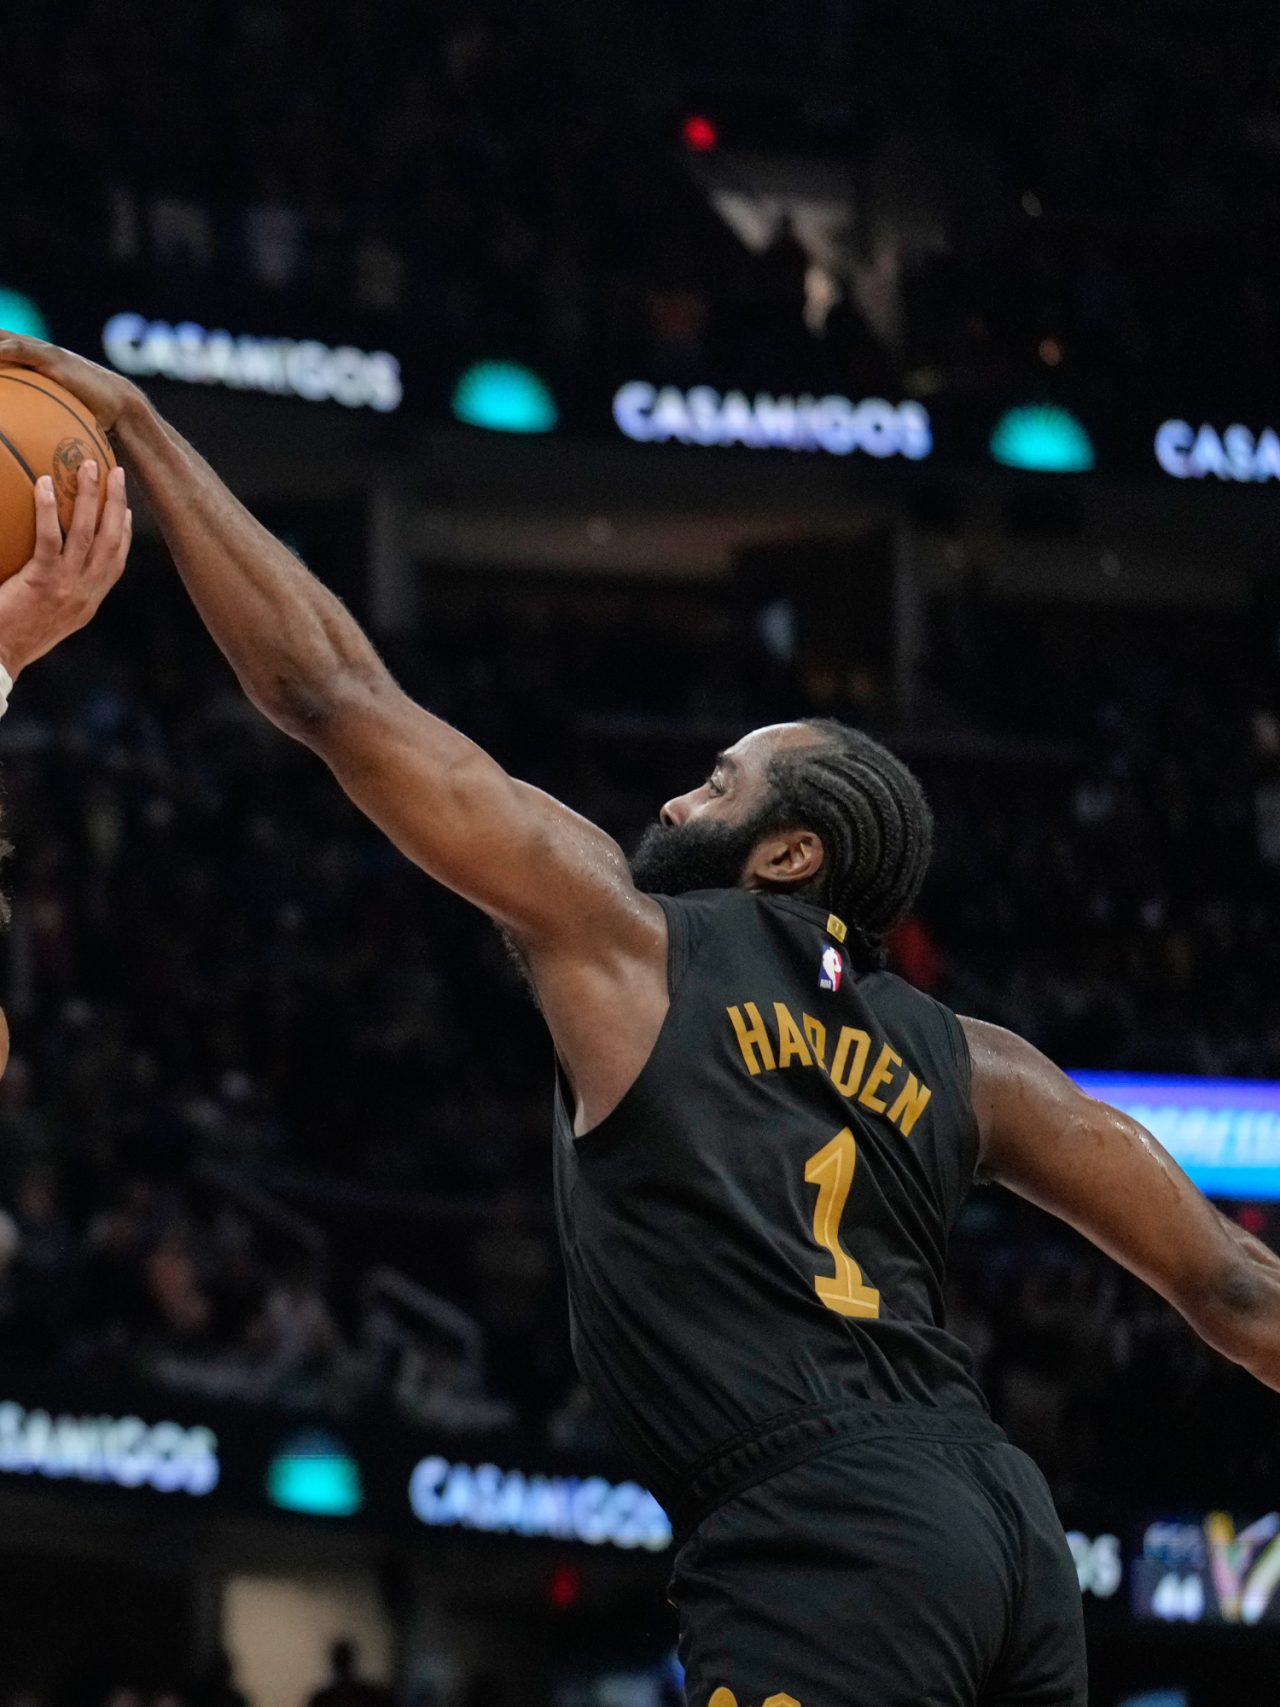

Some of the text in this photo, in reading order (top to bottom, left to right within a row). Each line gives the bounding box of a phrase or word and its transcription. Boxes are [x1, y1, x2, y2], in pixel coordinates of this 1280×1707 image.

[103, 311, 402, 412] CASAMIGOS
[612, 380, 934, 460] CASAMIGOS
[726, 1001, 932, 1137] HARDEN
[804, 1127, 880, 1319] 1
